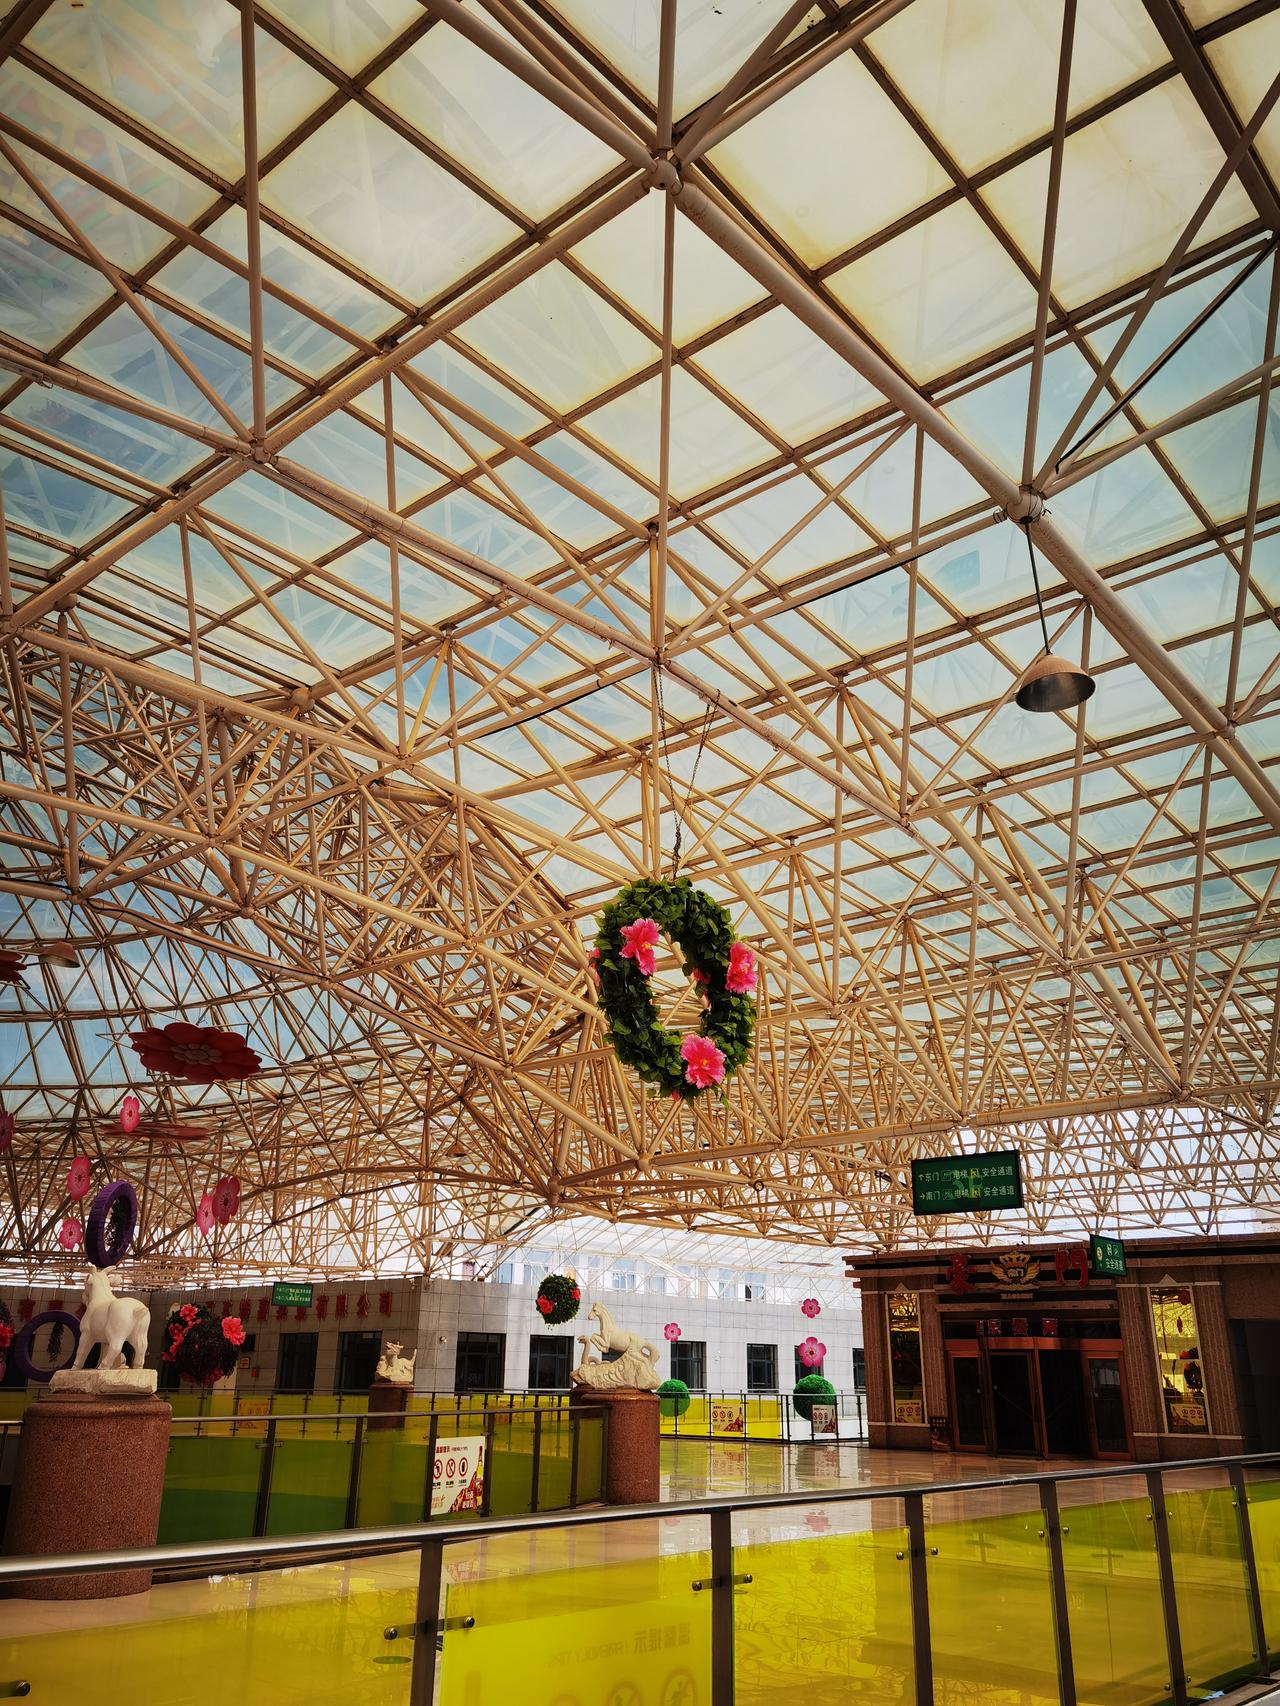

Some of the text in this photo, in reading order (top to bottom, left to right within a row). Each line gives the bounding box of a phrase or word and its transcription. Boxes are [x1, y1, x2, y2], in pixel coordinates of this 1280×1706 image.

[982, 1166, 1014, 1178] 安全通道
[984, 1185, 1015, 1197] 安全通道
